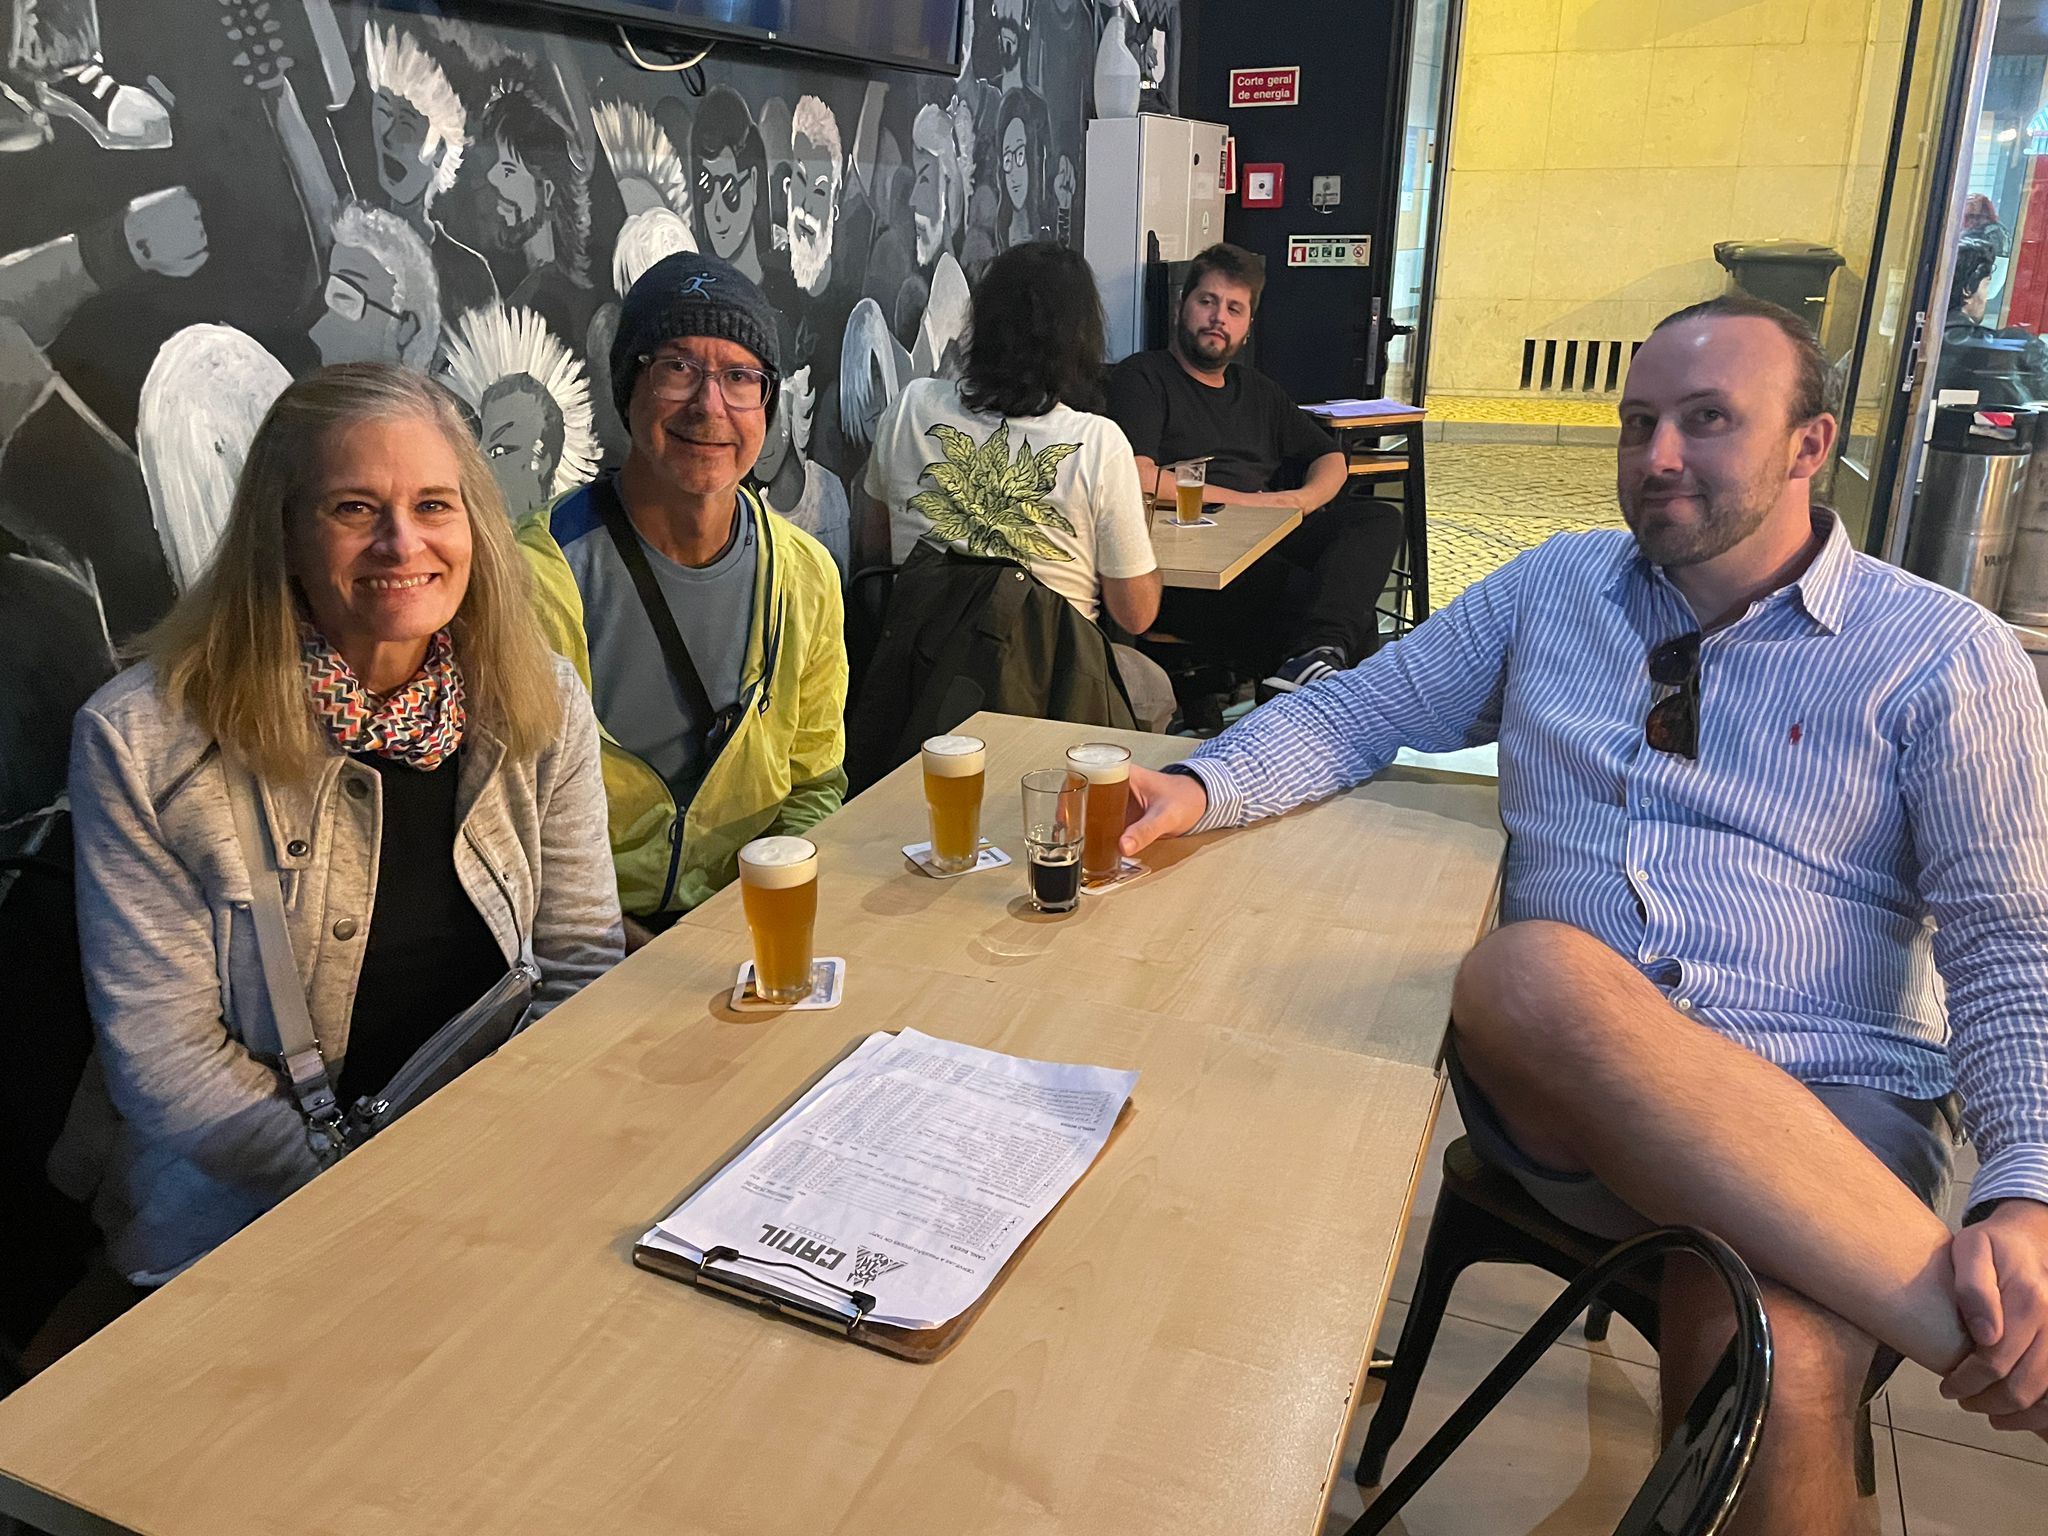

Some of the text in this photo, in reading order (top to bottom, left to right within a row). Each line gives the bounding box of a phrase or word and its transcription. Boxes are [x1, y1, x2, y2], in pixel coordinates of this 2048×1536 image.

[1237, 74, 1292, 87] Corte geral
[1238, 88, 1290, 101] de energia
[758, 1223, 847, 1270] CANIL
